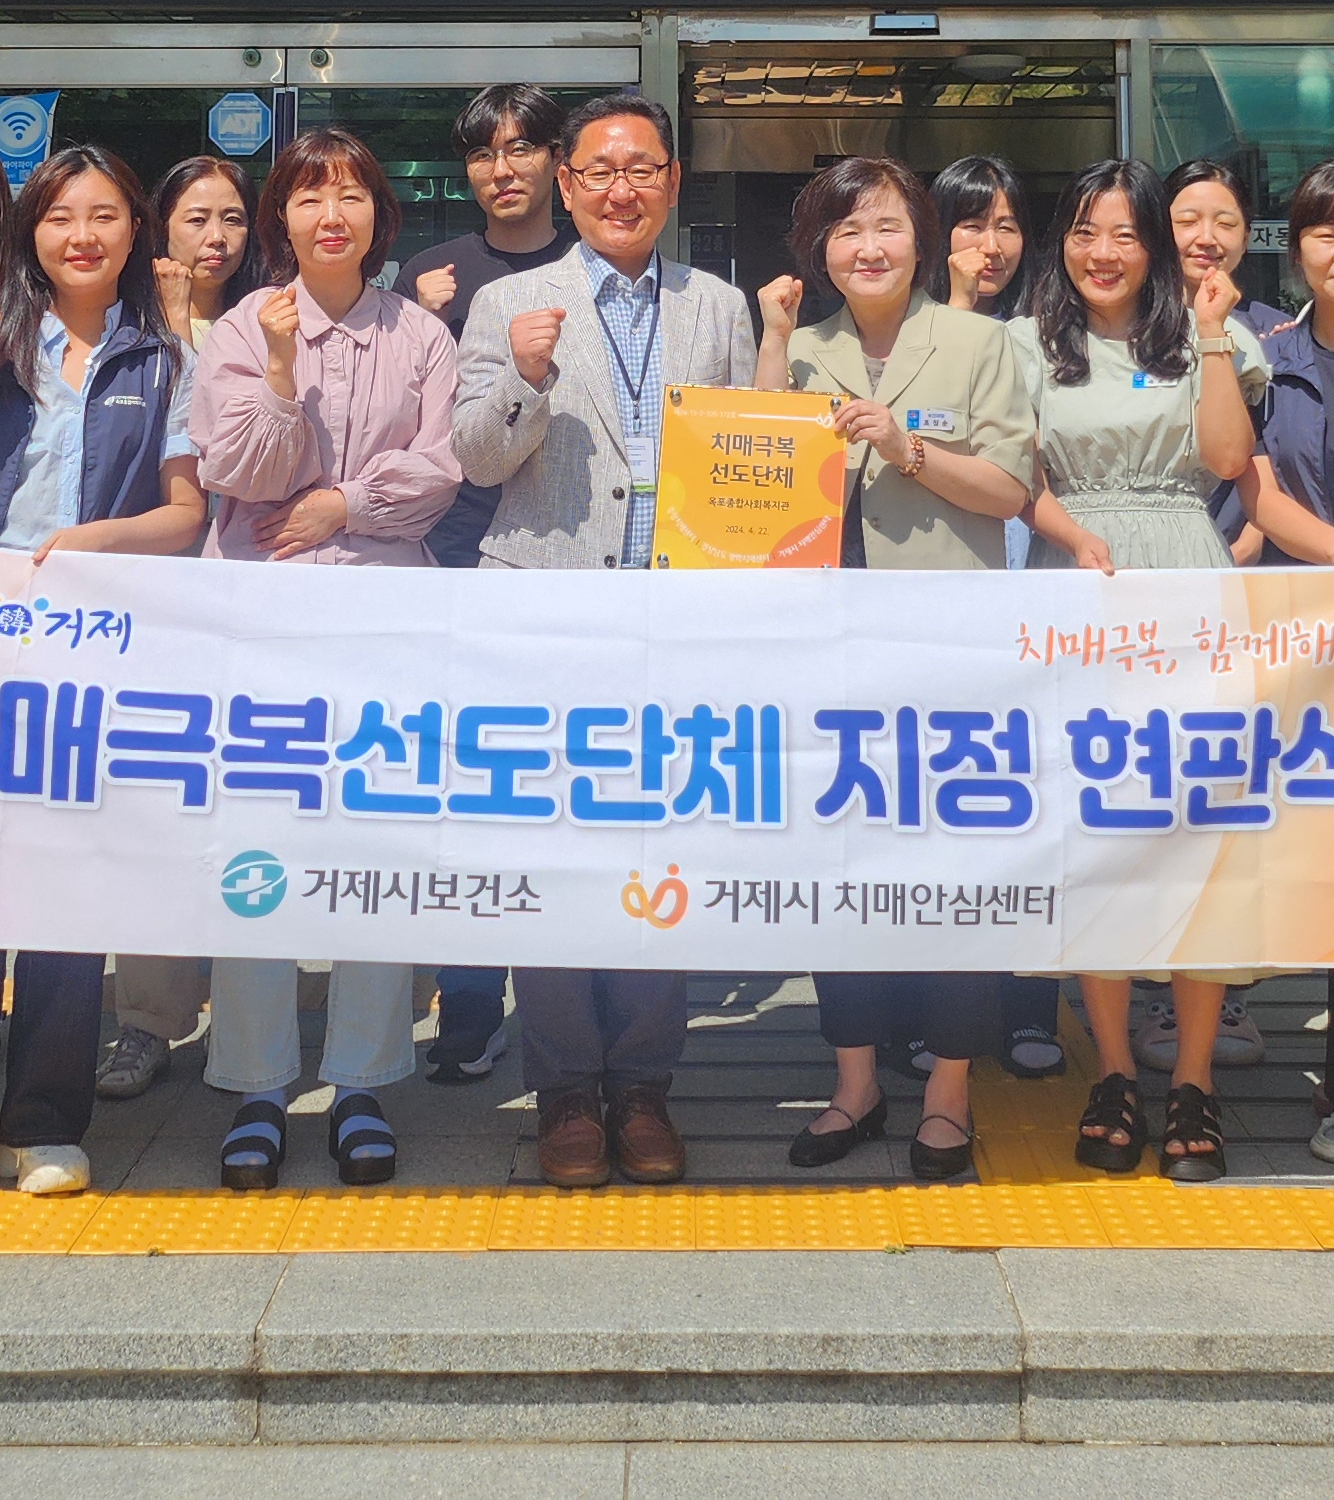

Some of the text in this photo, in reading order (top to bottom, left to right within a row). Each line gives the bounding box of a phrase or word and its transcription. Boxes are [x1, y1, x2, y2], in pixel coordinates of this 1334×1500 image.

[711, 433, 795, 459] 치매극복
[710, 463, 794, 489] 선도단체
[708, 496, 790, 511] 옥포종합사회복지관
[44, 607, 133, 656] 거제
[1015, 618, 1180, 675] 치매극복,
[813, 704, 1035, 829] 지정
[303, 867, 543, 919] 거제시보건소
[702, 878, 1057, 928] 거제시 치매안심센터
